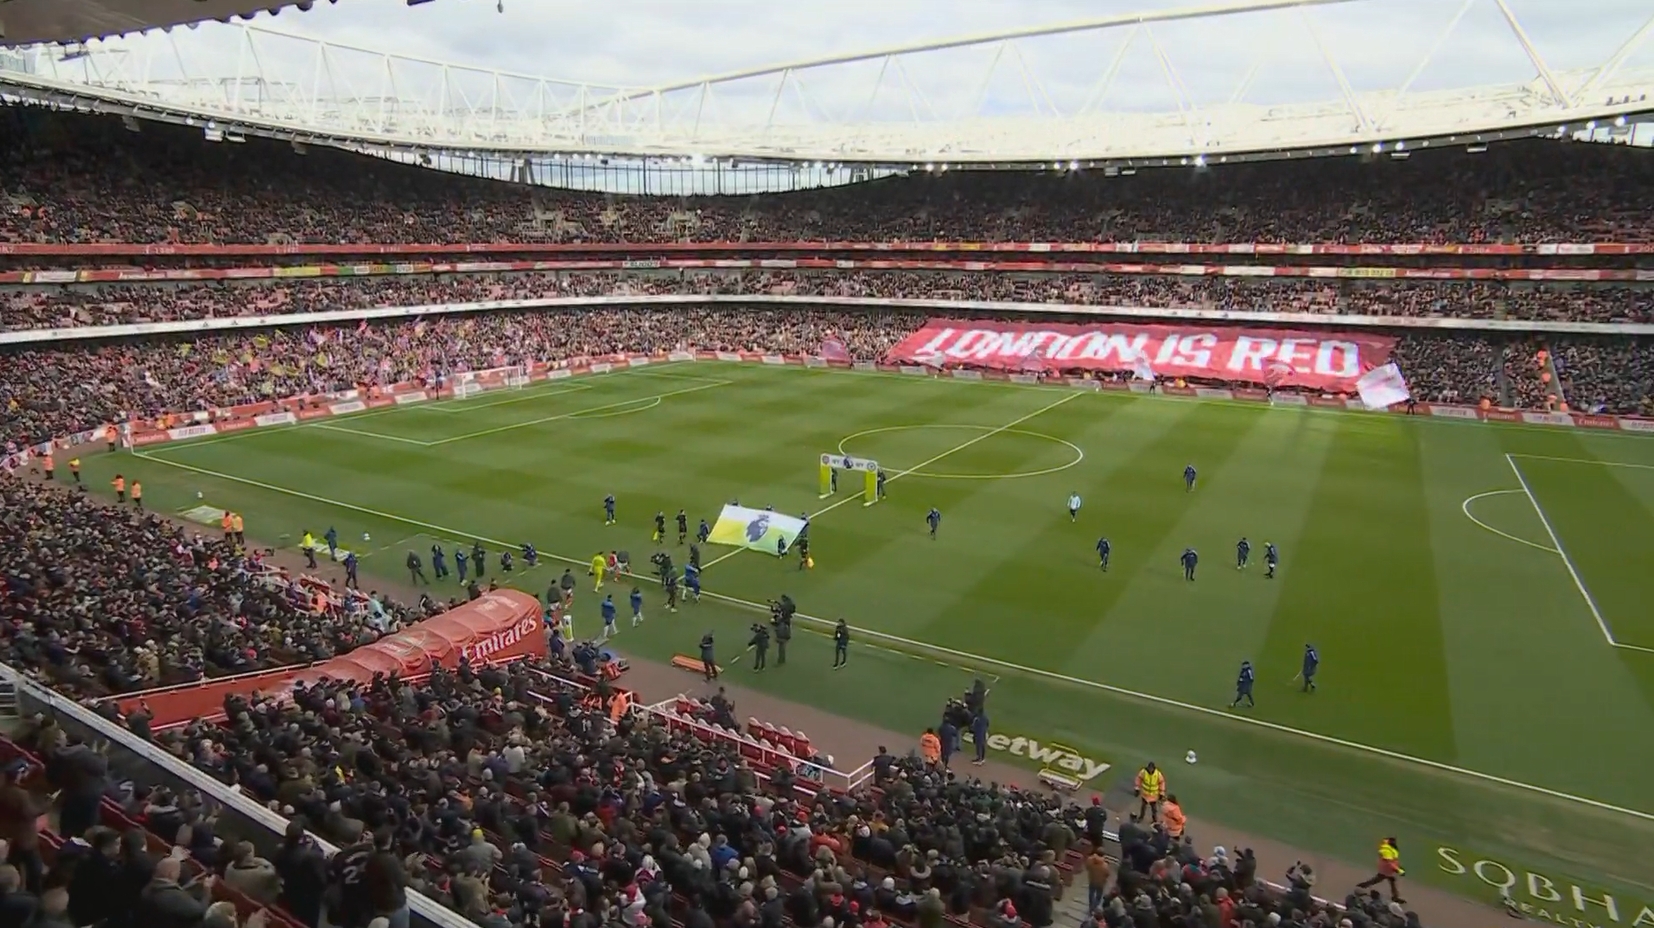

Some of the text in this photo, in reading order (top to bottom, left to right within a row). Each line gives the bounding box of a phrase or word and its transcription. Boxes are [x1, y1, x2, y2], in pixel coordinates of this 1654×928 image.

[1154, 333, 1218, 368] IS
[1227, 336, 1361, 377] RED
[462, 615, 537, 659] Emirates
